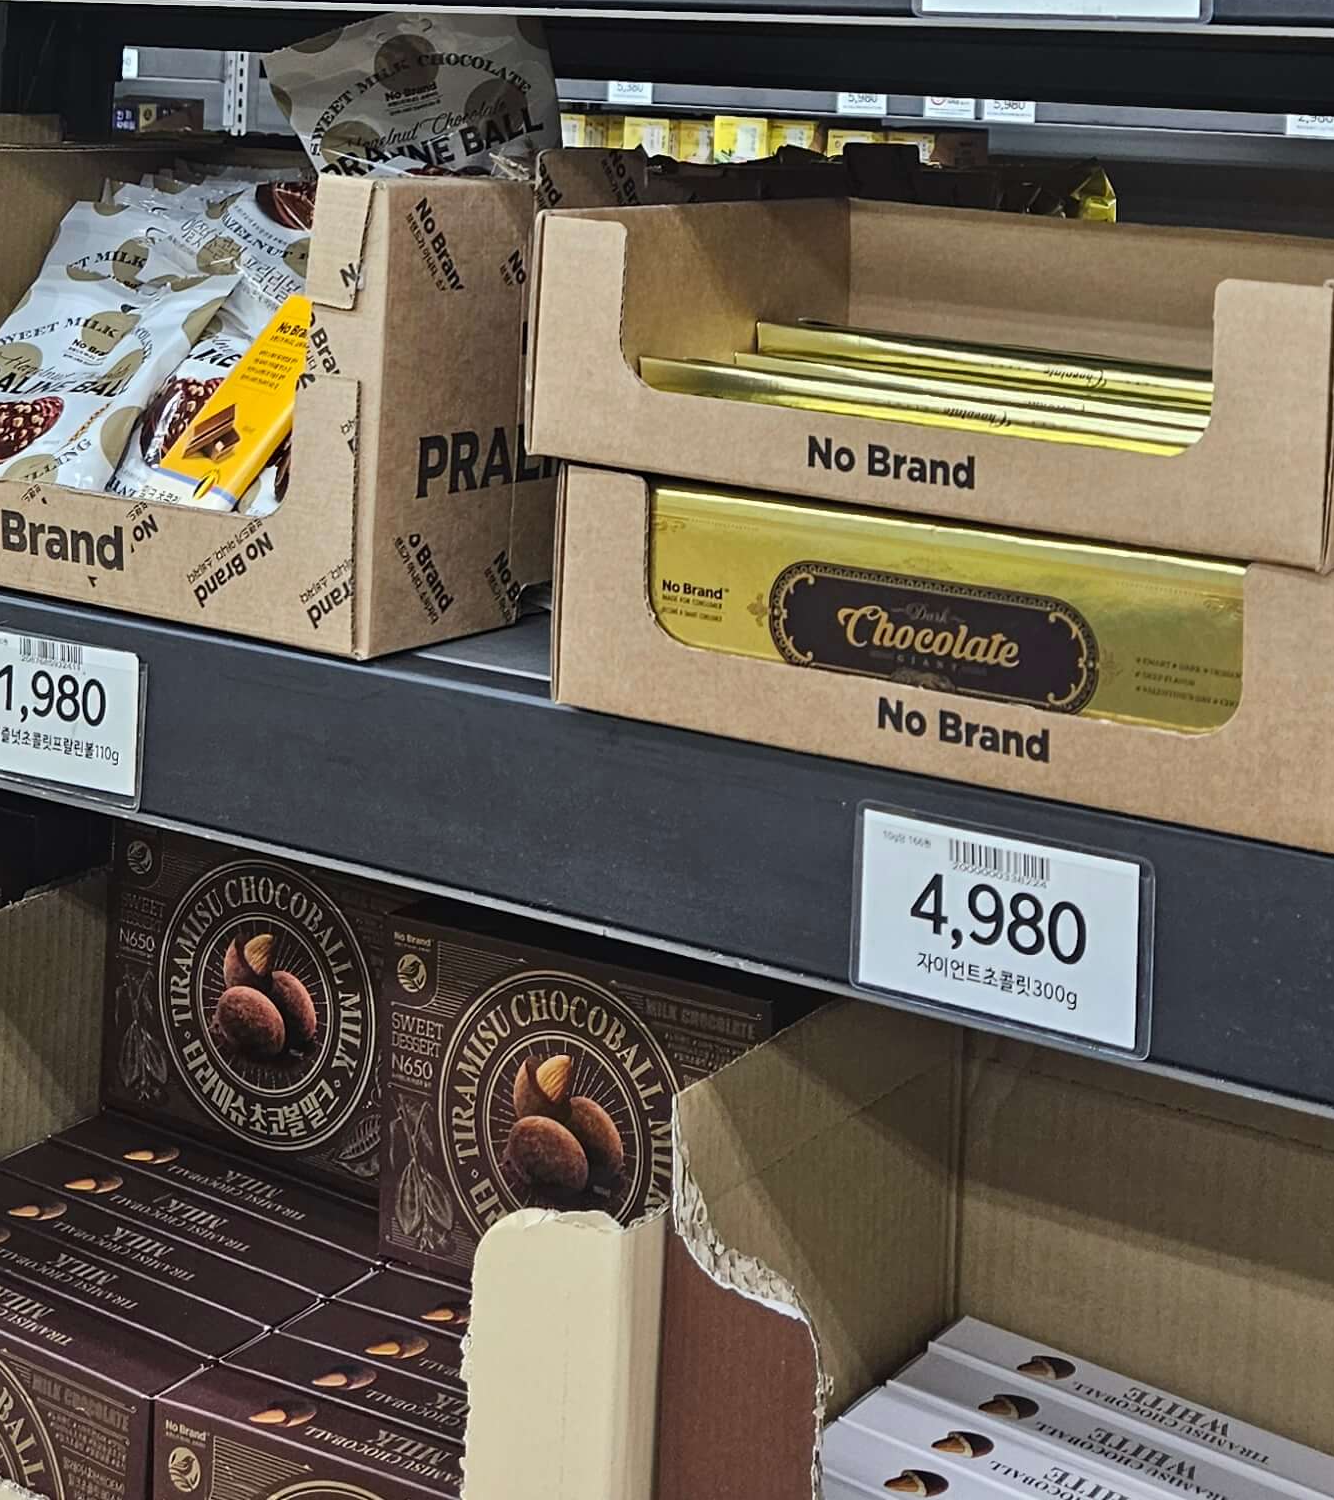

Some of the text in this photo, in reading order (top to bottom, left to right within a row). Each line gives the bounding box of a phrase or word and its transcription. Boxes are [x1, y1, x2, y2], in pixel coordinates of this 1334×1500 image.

[418, 52, 532, 96] CHOCOLATE
[459, 108, 544, 157] BALL
[837, 605, 1020, 668] Chocolate
[905, 602, 948, 624] Dark
[877, 697, 1050, 763] No Brand
[910, 873, 1087, 965] 4,980
[171, 874, 364, 1078] TIRAMISU CHOCOBALL MILK
[917, 953, 1078, 1010] 자이언트초콜릿300g
[391, 1012, 445, 1041] SWEET
[391, 1031, 442, 1059] DESSERT
[390, 1053, 434, 1080] N650
[447, 990, 652, 1166] TIRAMISU CHOCOBALL
[1123, 1387, 1230, 1438] WHITE
